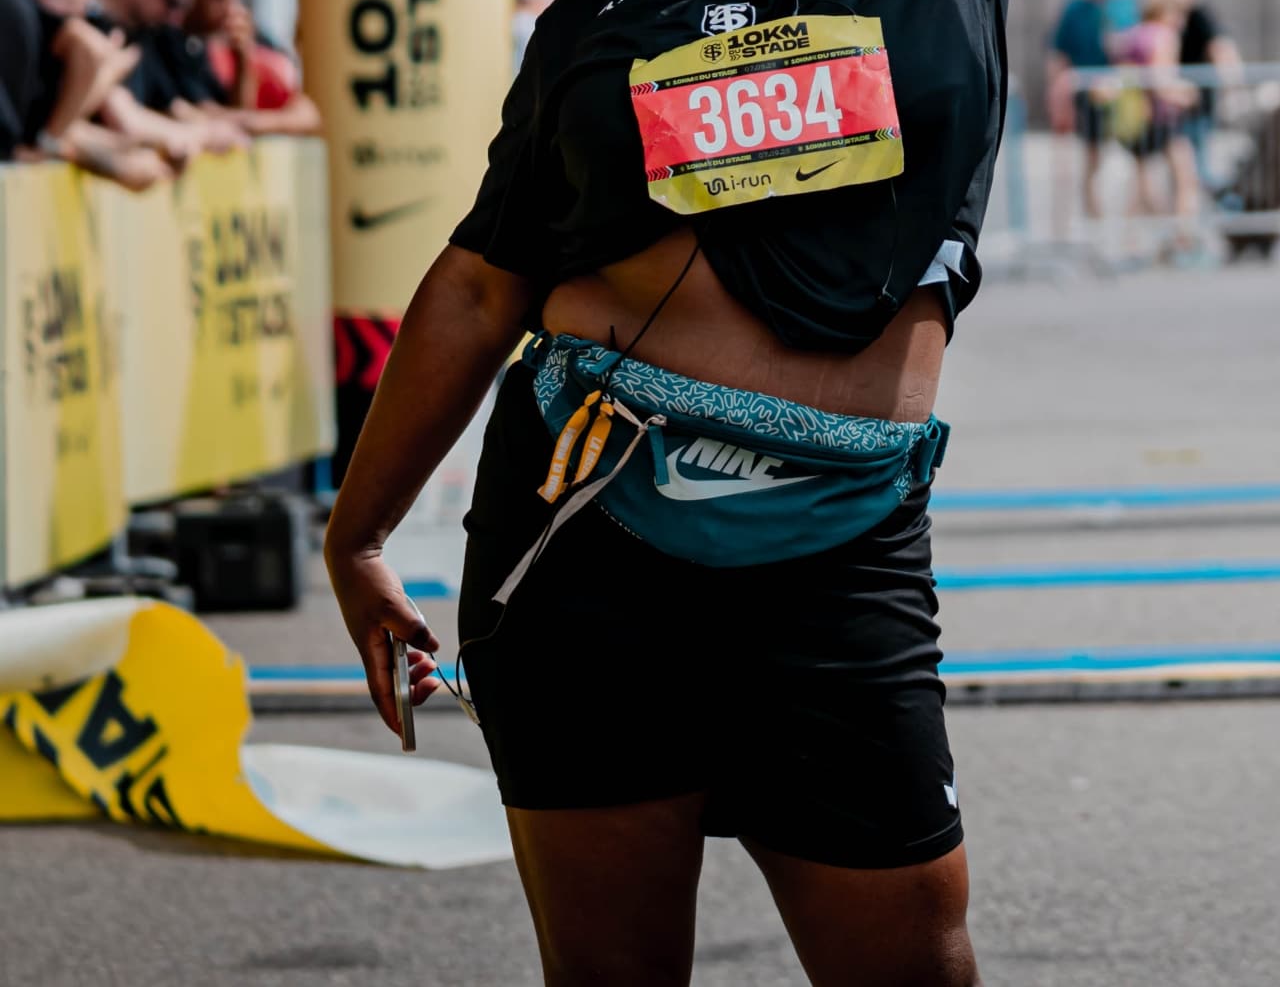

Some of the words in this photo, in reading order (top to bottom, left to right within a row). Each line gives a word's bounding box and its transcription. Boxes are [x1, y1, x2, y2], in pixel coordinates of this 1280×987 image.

[727, 22, 809, 50] 10KM
[742, 37, 810, 58] STADE
[688, 65, 843, 153] 3634
[731, 174, 771, 191] i-run
[680, 437, 785, 480] NIKE
